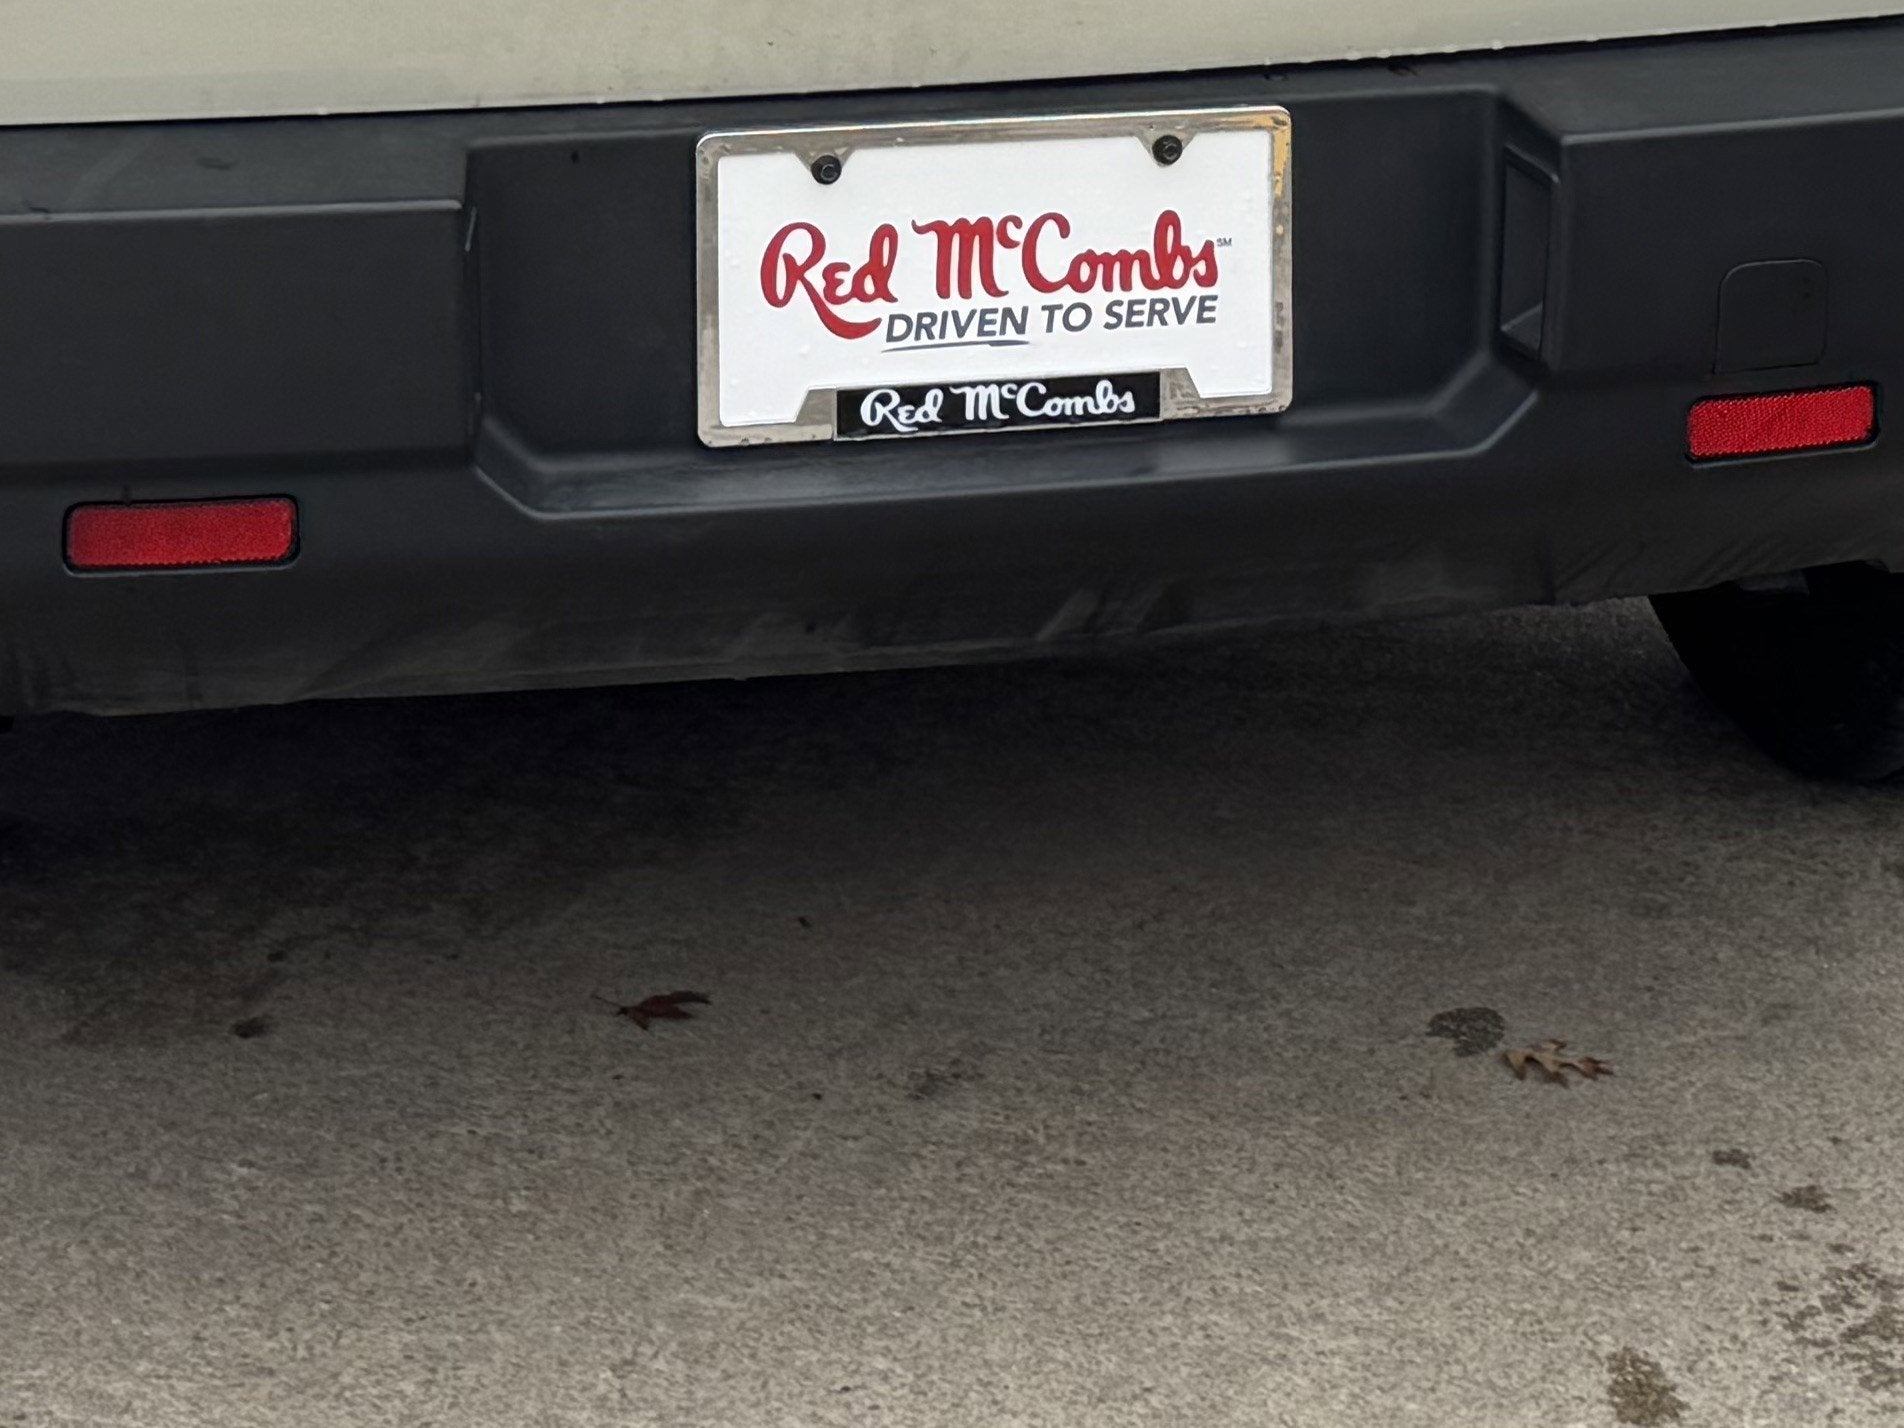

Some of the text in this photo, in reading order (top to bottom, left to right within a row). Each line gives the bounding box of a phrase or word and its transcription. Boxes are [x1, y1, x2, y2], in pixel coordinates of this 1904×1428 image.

[760, 221, 899, 340] Red
[911, 209, 1219, 300] McCombs
[885, 294, 1219, 343] DRIVEN TO SERVE
[859, 379, 1136, 432] Red McCombs
